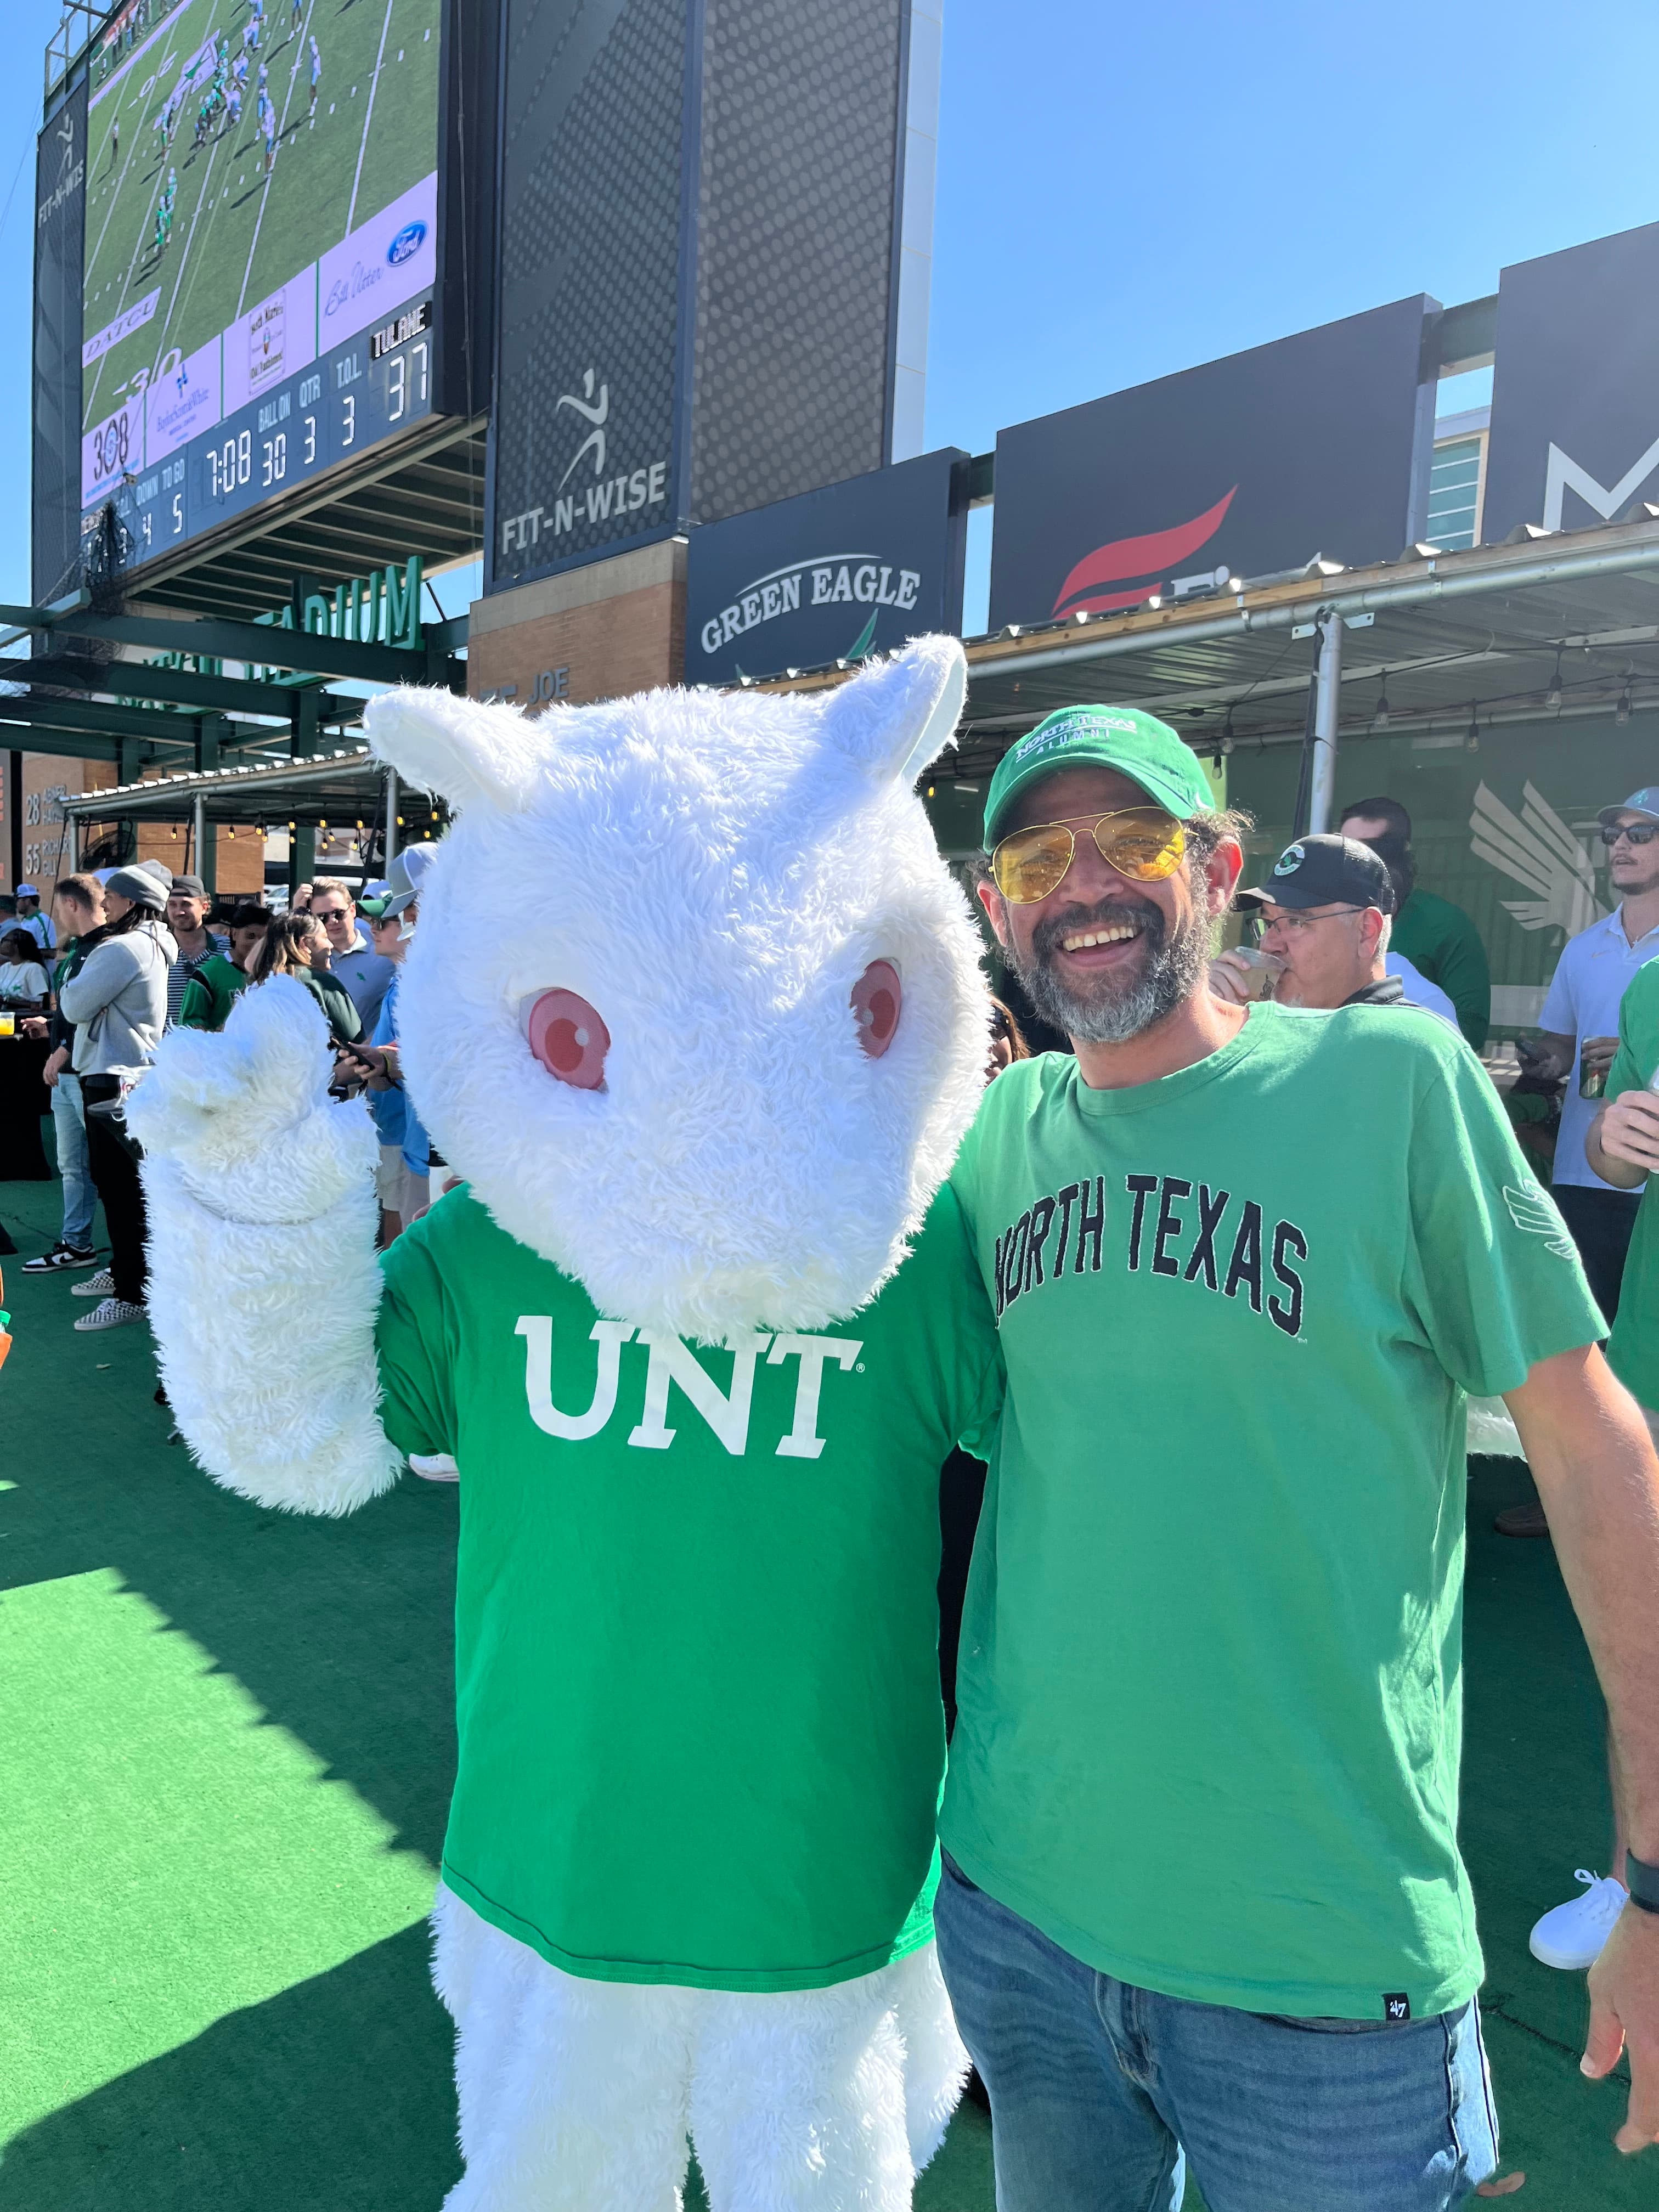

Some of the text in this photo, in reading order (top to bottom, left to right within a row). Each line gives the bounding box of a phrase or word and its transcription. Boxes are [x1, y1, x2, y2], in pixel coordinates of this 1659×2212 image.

[392, 229, 422, 262] Ford
[373, 303, 426, 358] TULANE
[299, 374, 321, 409] QTR
[389, 342, 427, 422] 37
[258, 392, 291, 433] BALL ON
[342, 396, 355, 446] 3
[206, 429, 251, 496] 7:08
[262, 433, 286, 487] 30
[304, 416, 316, 464] 3
[136, 474, 159, 506] DOWN
[162, 466, 172, 490] TO
[174, 459, 185, 484] GO
[142, 512, 151, 545] 4
[173, 494, 182, 534] 5
[501, 461, 666, 555] FIT-N-WISE
[700, 566, 922, 654] GREEN EAGLE
[528, 667, 569, 704] JOE
[1016, 714, 1137, 759] NORTH TEXAS
[1036, 729, 1109, 755] ALUMNI
[26, 794, 40, 826] 28
[26, 843, 40, 875] 55
[994, 1173, 1308, 1338] NORTH TEXAS
[514, 1315, 864, 1459] UNT
